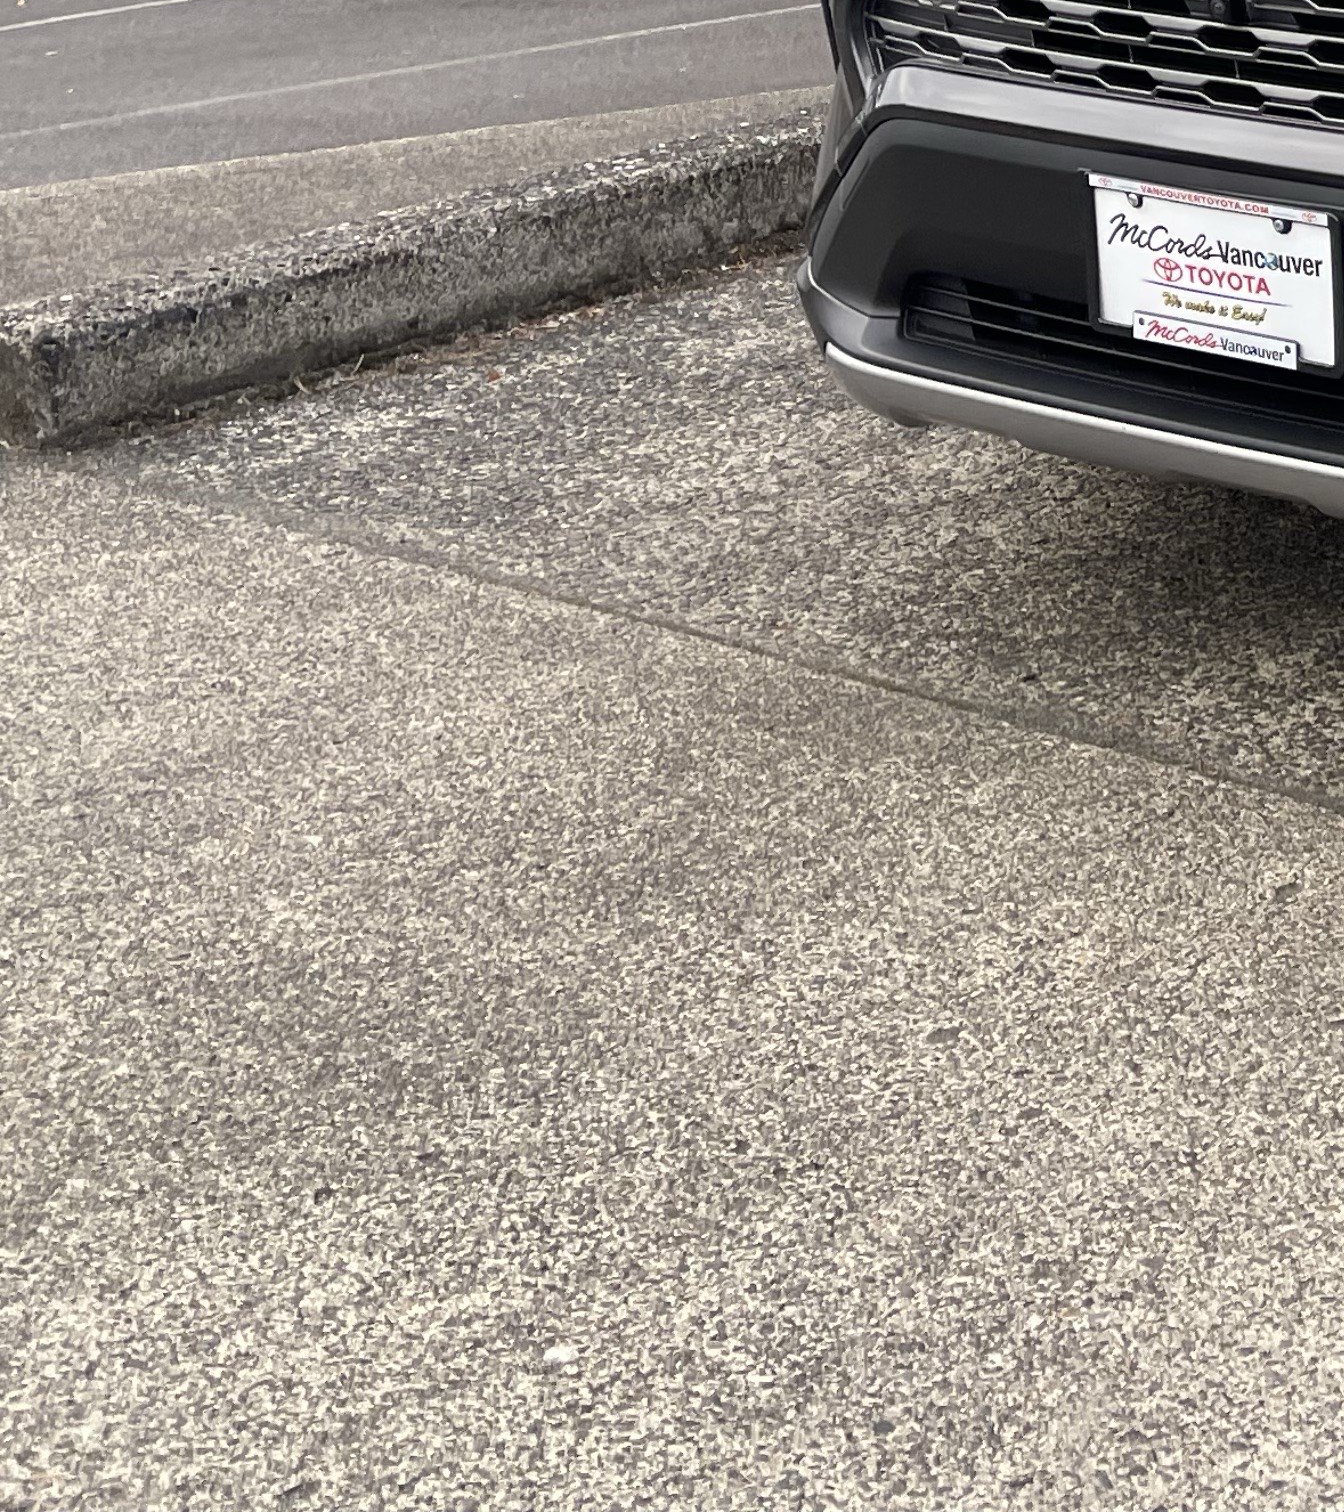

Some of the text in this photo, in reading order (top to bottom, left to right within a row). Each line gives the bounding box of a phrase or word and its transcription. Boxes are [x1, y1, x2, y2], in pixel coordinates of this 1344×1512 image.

[1140, 185, 1269, 214] VANCOUVERTOYOTA.COM
[1184, 264, 1271, 296] TOYOTA
[1145, 319, 1217, 349] McCords
